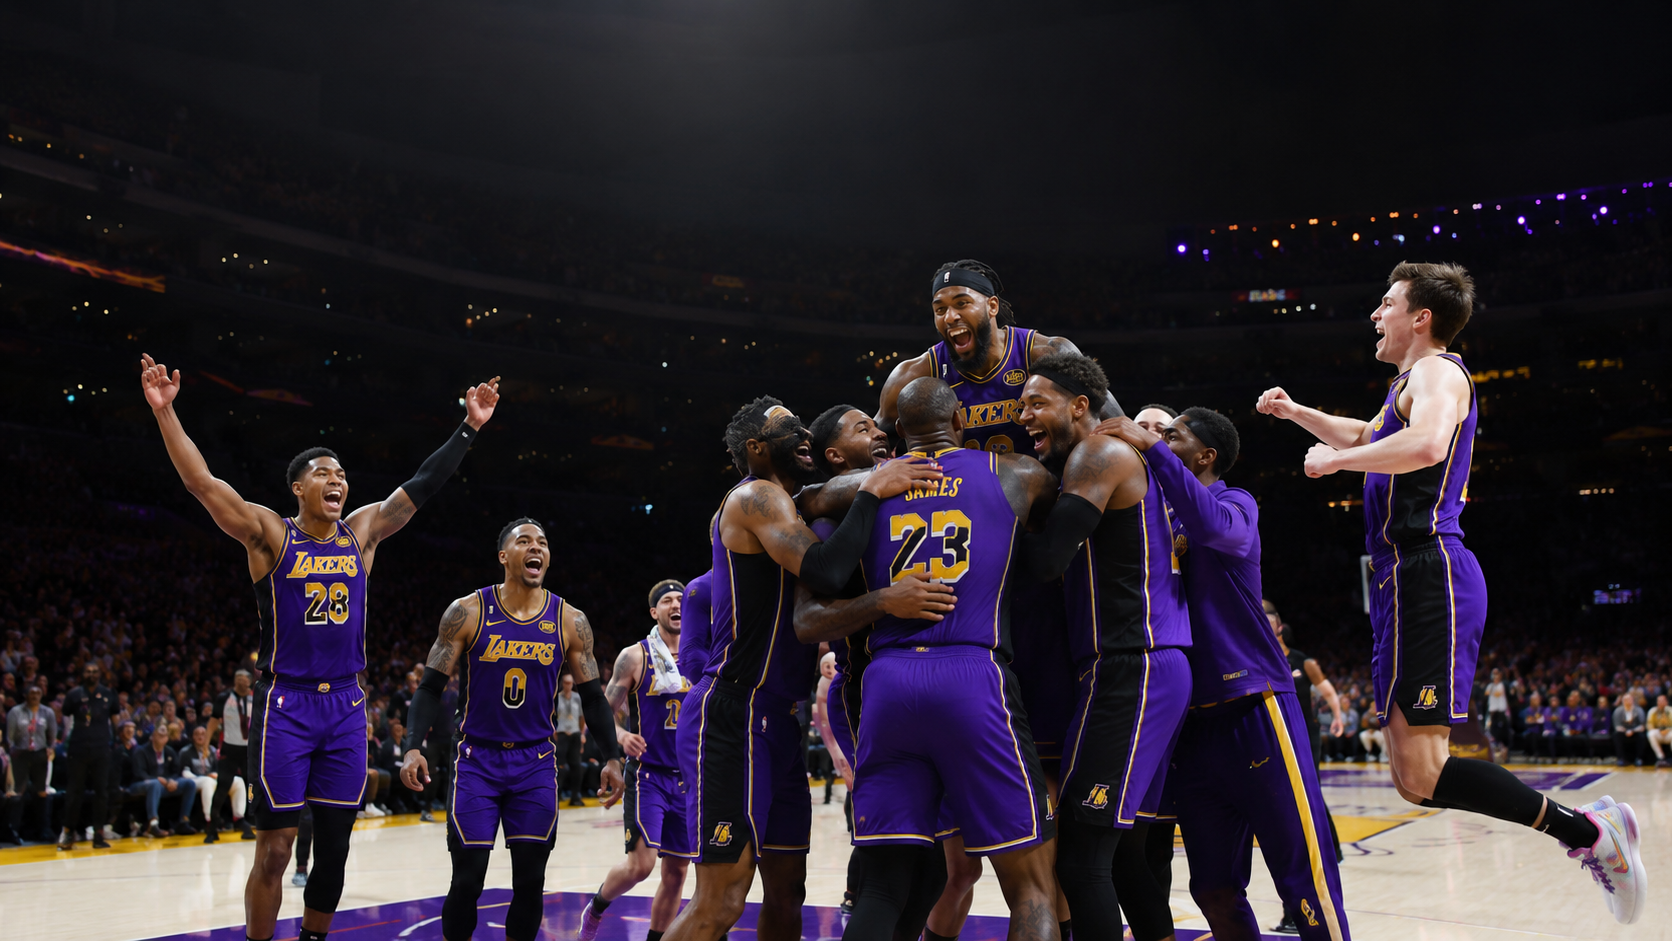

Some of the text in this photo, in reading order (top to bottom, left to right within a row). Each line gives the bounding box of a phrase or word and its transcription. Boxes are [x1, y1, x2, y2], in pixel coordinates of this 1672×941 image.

[958, 399, 1026, 428] KERS
[286, 551, 358, 578] LAKERS
[890, 510, 971, 586] 23
[304, 582, 349, 625] 28
[478, 634, 556, 666] LAKERS
[502, 667, 527, 709] 0
